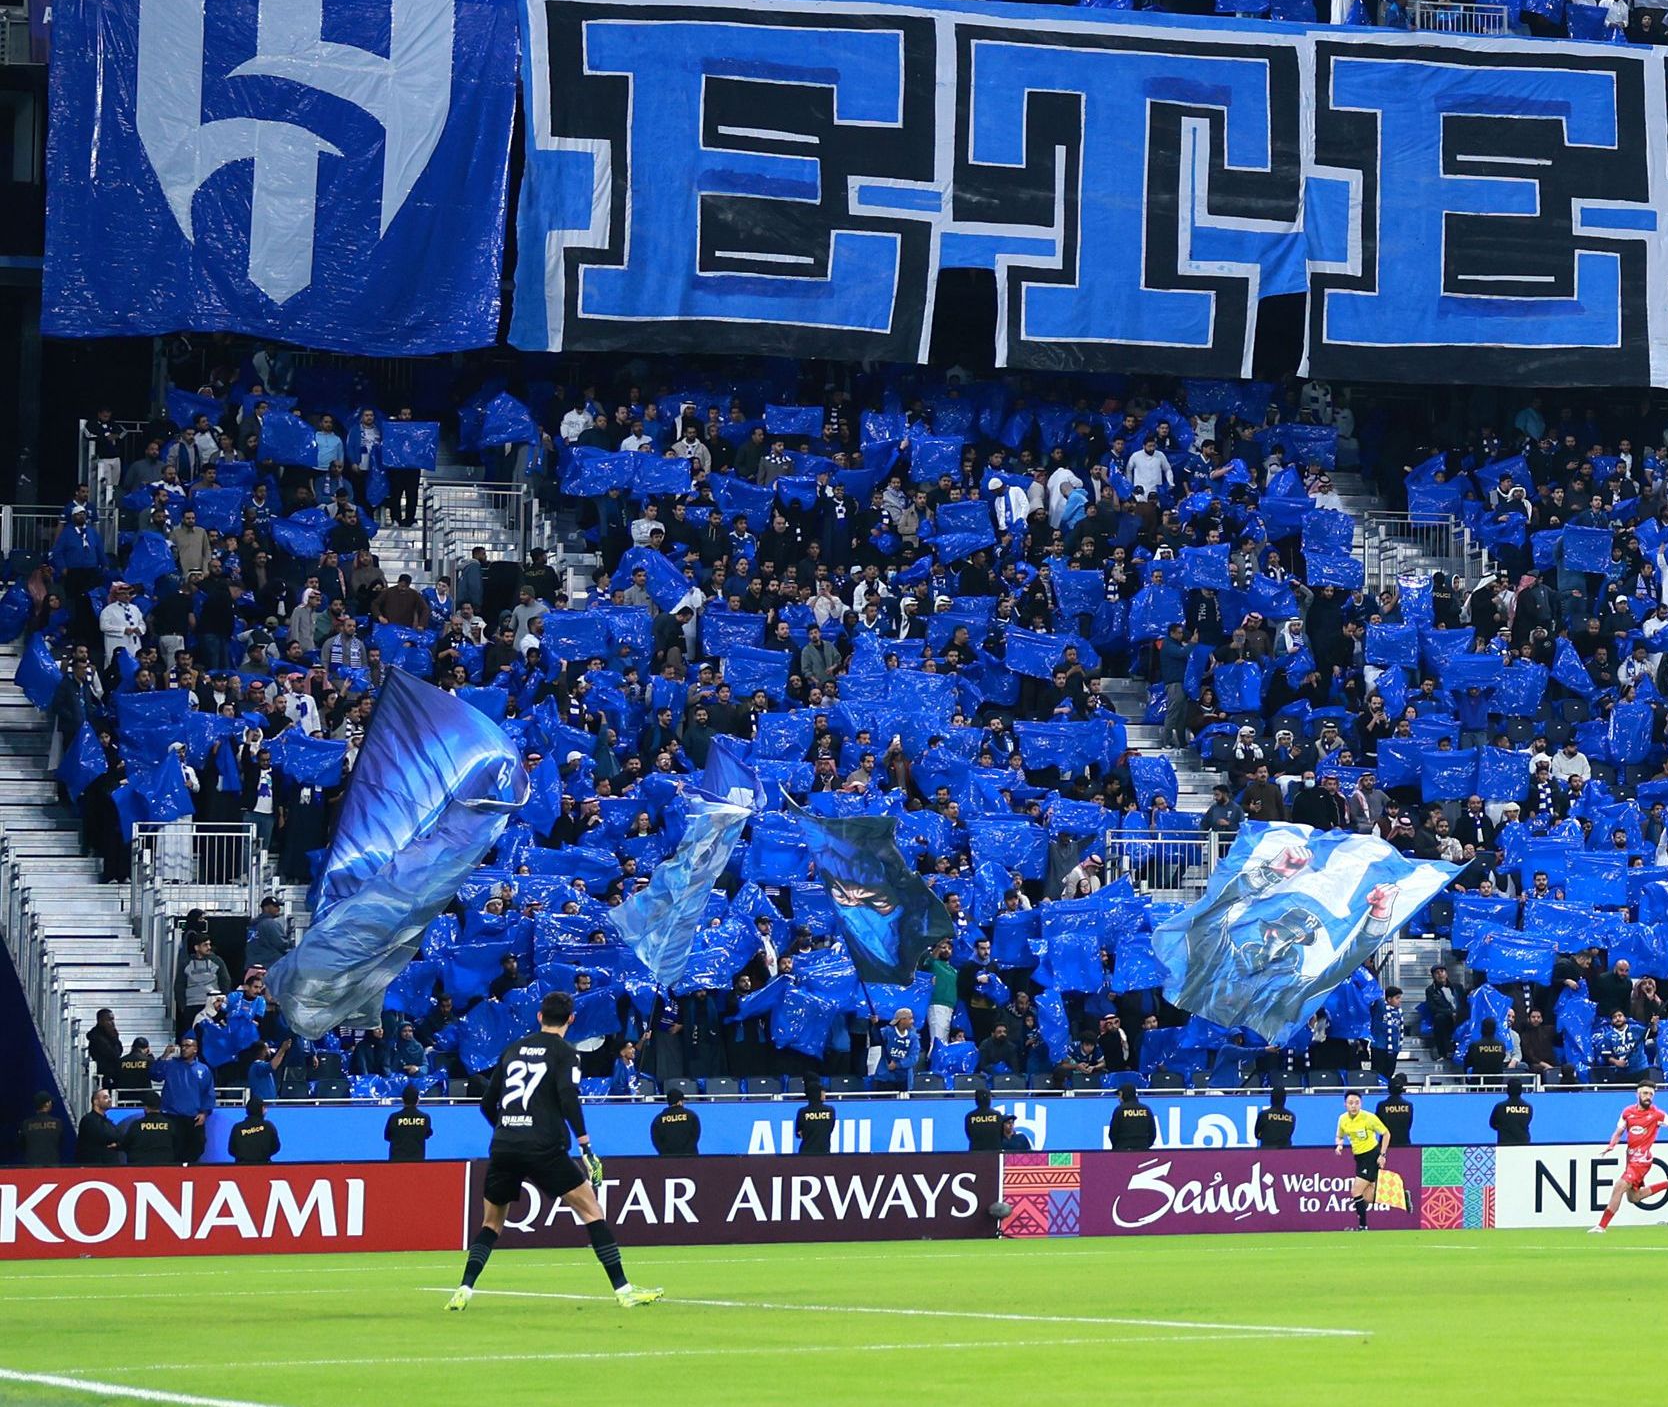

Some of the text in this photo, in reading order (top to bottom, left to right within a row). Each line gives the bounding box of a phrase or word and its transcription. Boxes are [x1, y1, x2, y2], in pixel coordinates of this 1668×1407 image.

[1479, 1045, 1502, 1053] POLICE
[121, 1061, 146, 1069] POLICE
[502, 1060, 547, 1111] 37
[1123, 1109, 1147, 1117] POLICE
[1385, 1104, 1409, 1113] POLICE
[1506, 1106, 1529, 1114] POLICE
[662, 1113, 688, 1124] POLICE
[805, 1112, 830, 1121] POLICE
[971, 1115, 997, 1124] POLICE
[1268, 1112, 1293, 1122] POLICE
[141, 1122, 168, 1131] POLICE
[398, 1118, 425, 1127] POLICE
[241, 1125, 264, 1136] Police
[726, 1172, 979, 1222] AIRWAYS
[1112, 1157, 1281, 1228] Saudi
[1299, 1195, 1319, 1212] to
[0, 1178, 364, 1243] KONAMI
